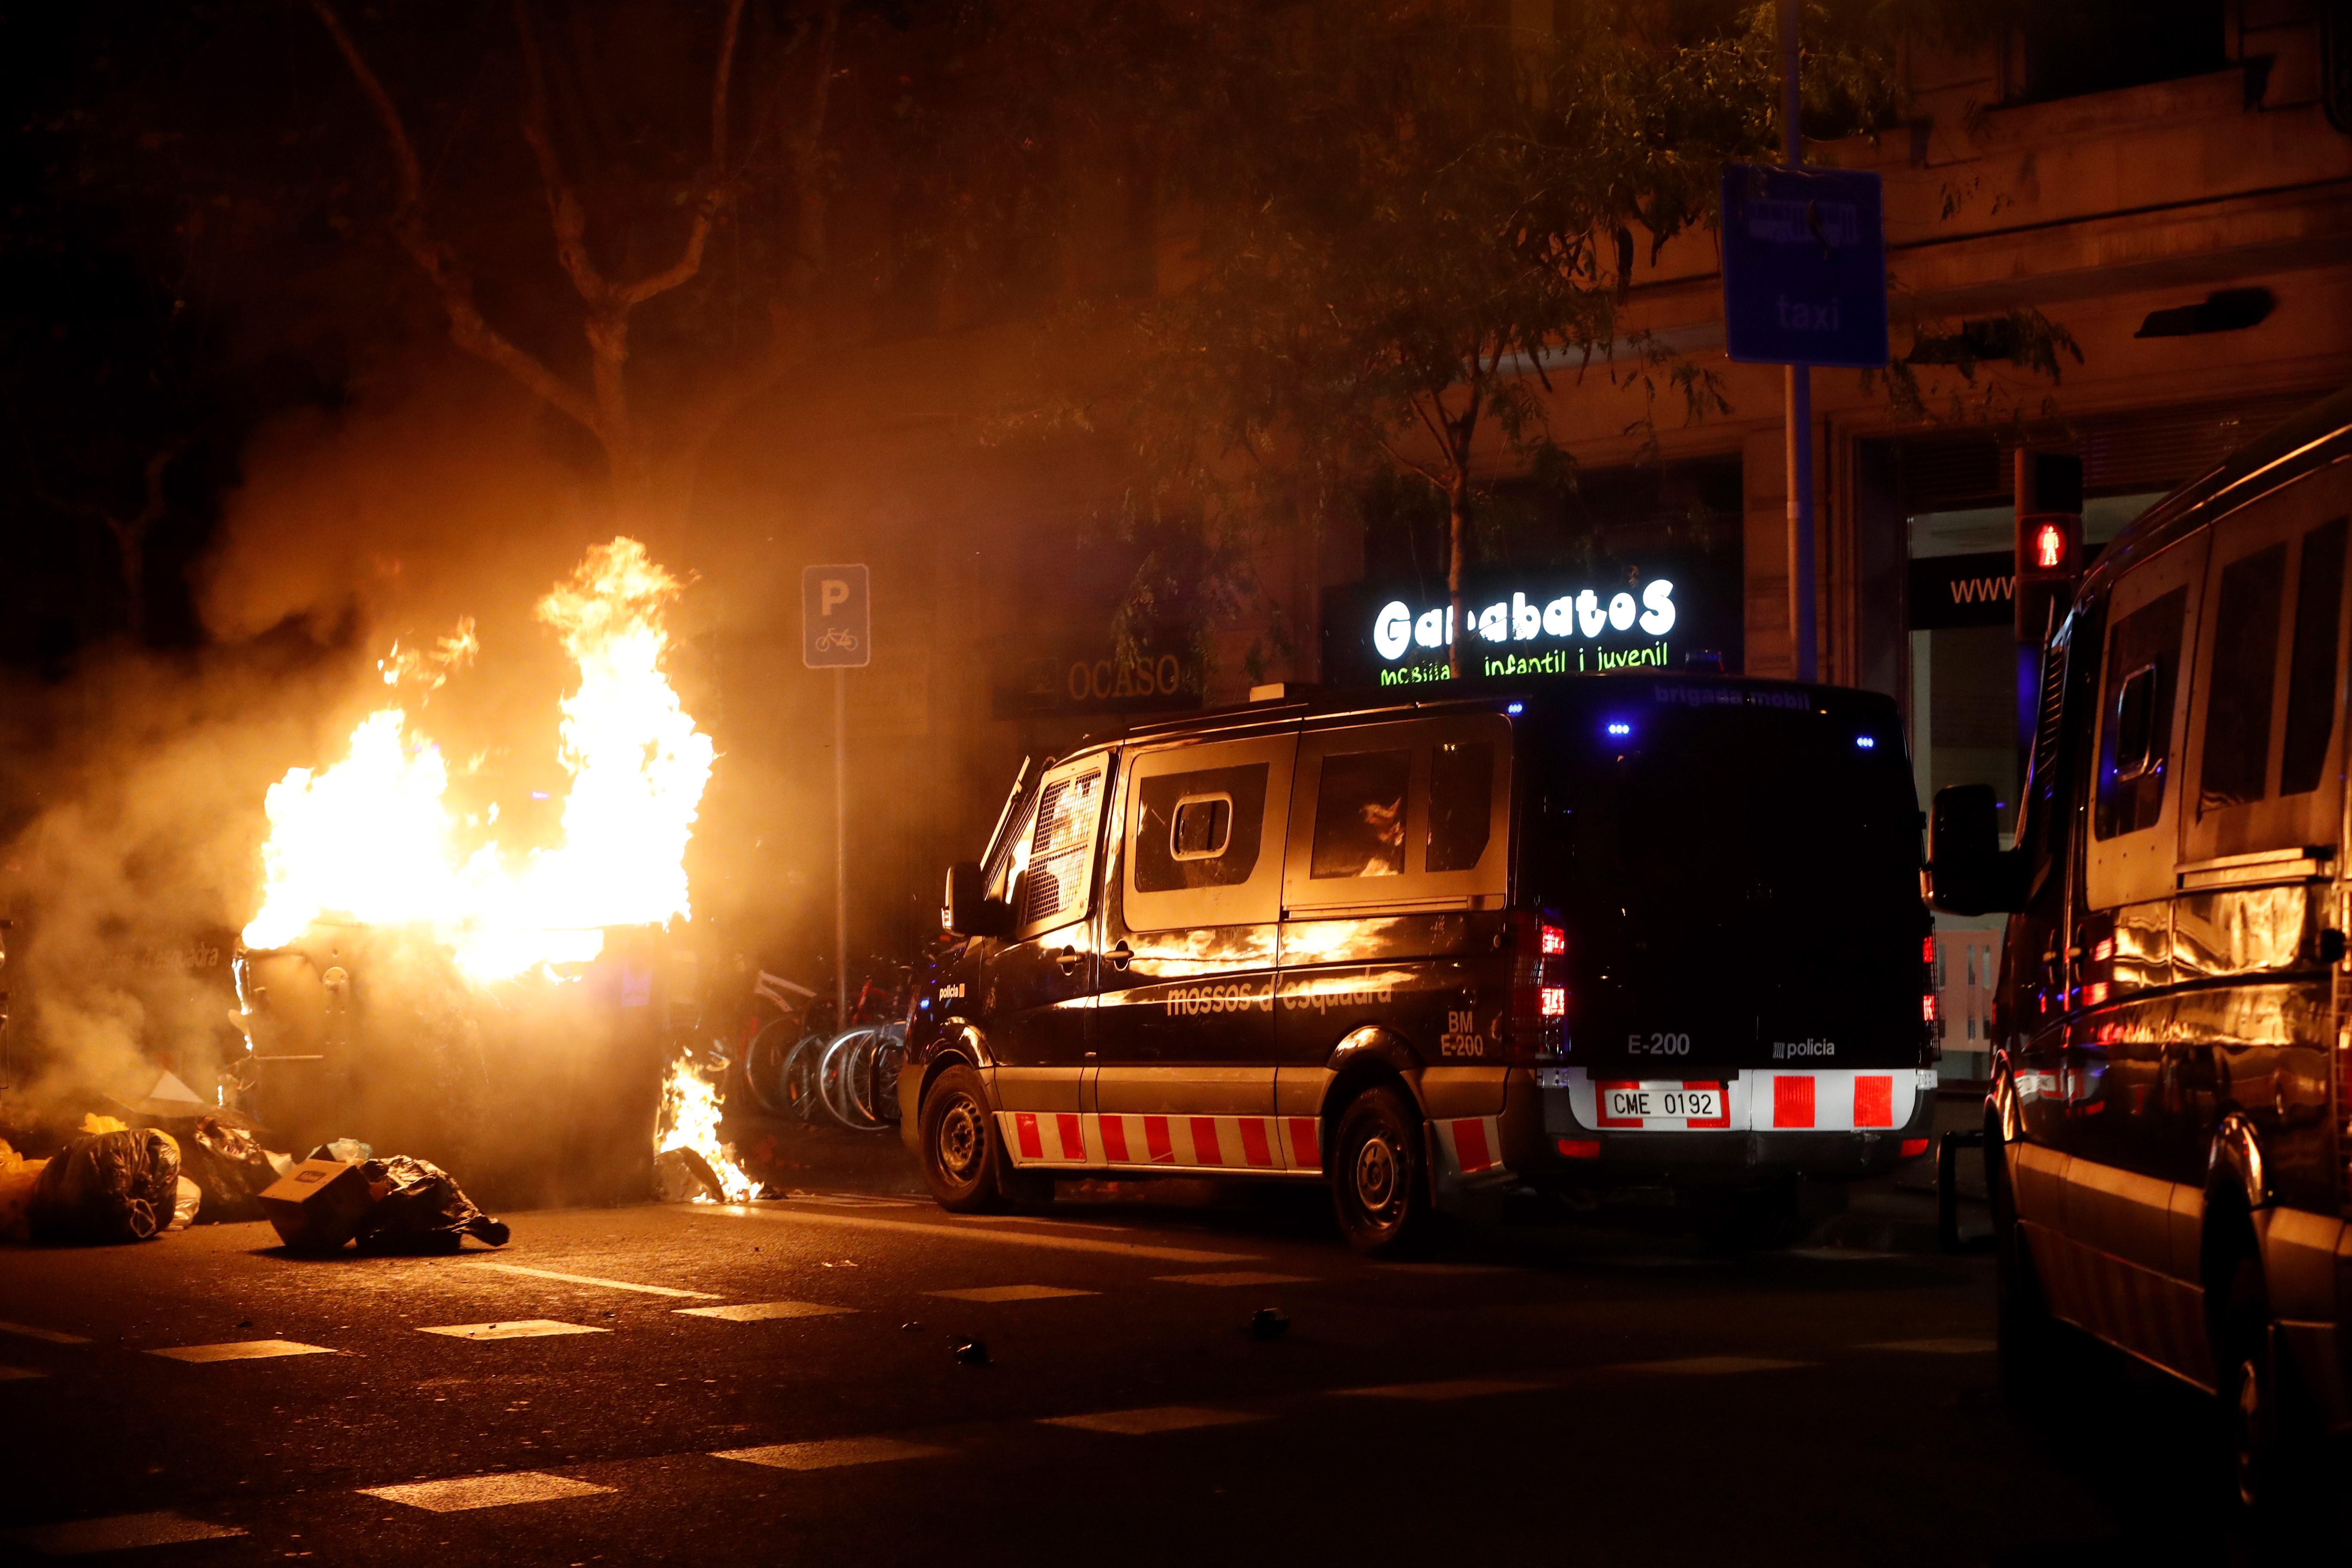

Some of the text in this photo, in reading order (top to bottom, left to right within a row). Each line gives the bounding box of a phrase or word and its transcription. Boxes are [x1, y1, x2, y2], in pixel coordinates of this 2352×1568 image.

[1776, 293, 1839, 331] taxi
[821, 580, 849, 616] P
[1485, 649, 1565, 676] infantil
[1578, 647, 1584, 672] i
[1597, 641, 1667, 671] juvenil
[1069, 655, 1180, 701] OCASO
[1654, 685, 1743, 707] brigada
[939, 984, 959, 1001] policia
[1167, 983, 1252, 1016] mossos
[1448, 1011, 1473, 1033] BM
[1441, 1035, 1483, 1057] E-200
[1628, 1033, 1690, 1056] E-200
[1787, 1038, 1835, 1060] policia
[1614, 1093, 1713, 1115] CME 0192
